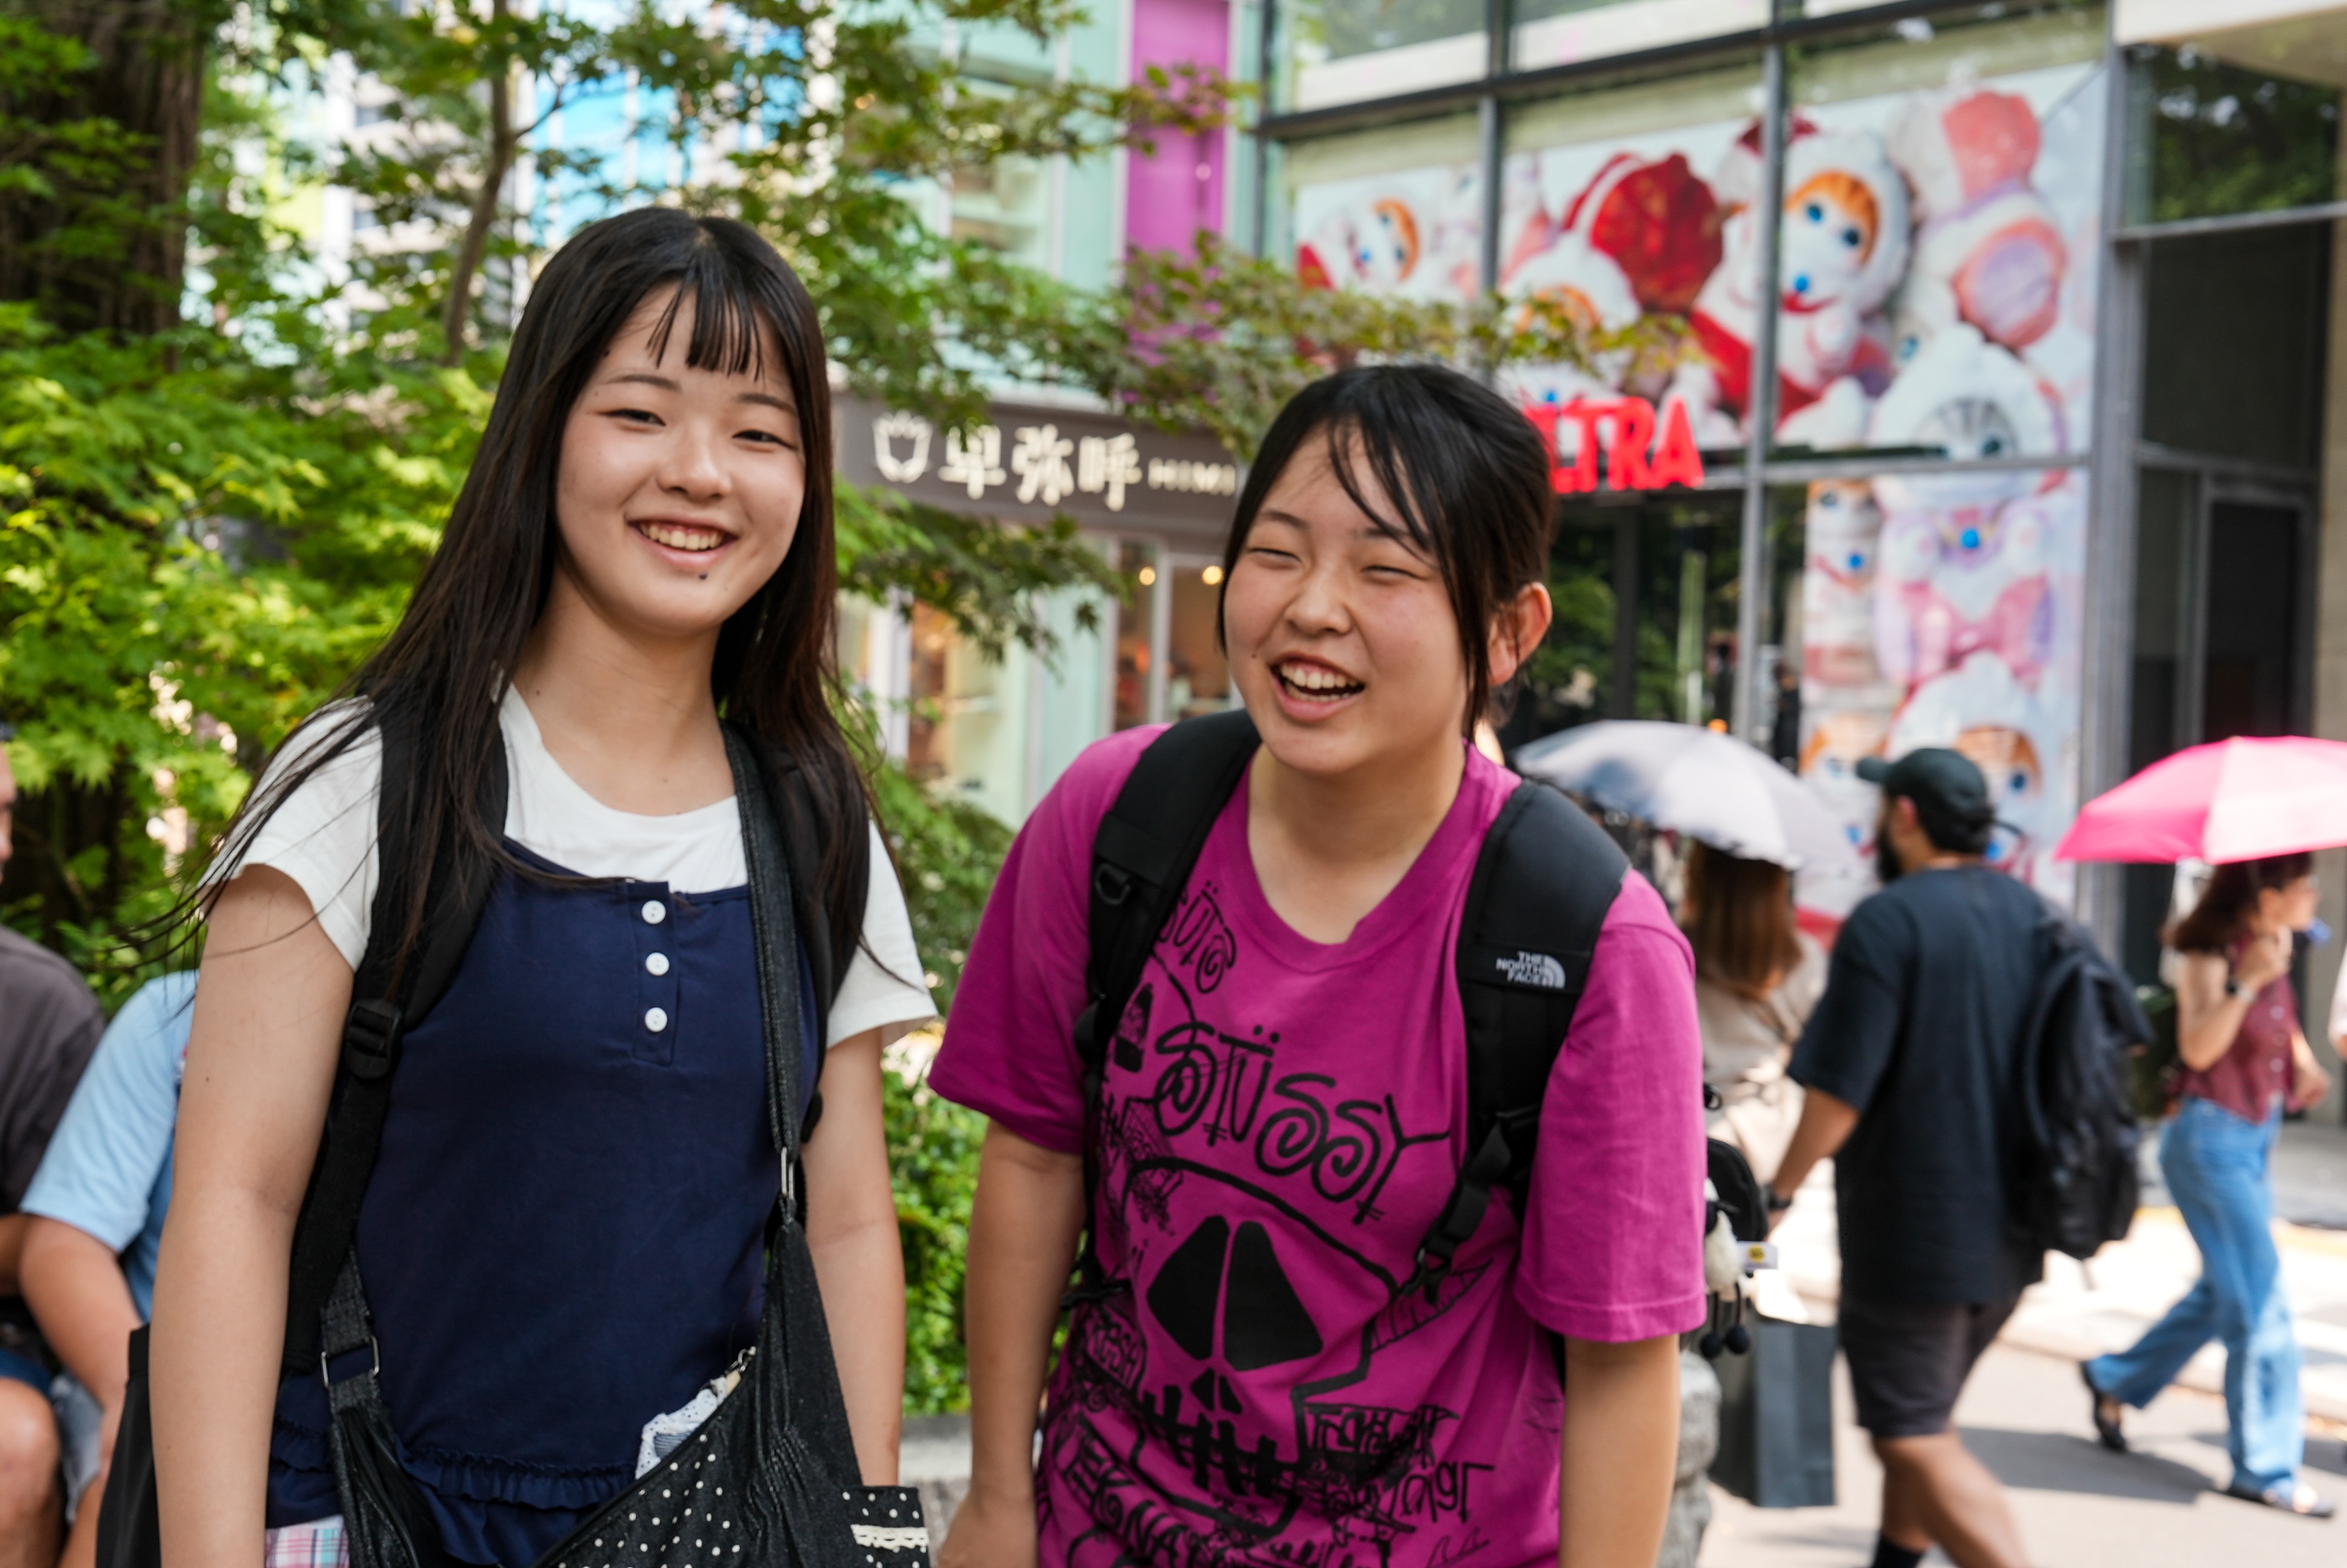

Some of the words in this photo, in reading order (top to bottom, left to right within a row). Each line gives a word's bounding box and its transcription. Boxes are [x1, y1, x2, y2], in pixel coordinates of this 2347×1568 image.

[1517, 950, 1543, 965] THE
[1495, 957, 1545, 976] NORTH
[1507, 969, 1543, 985] FACE
